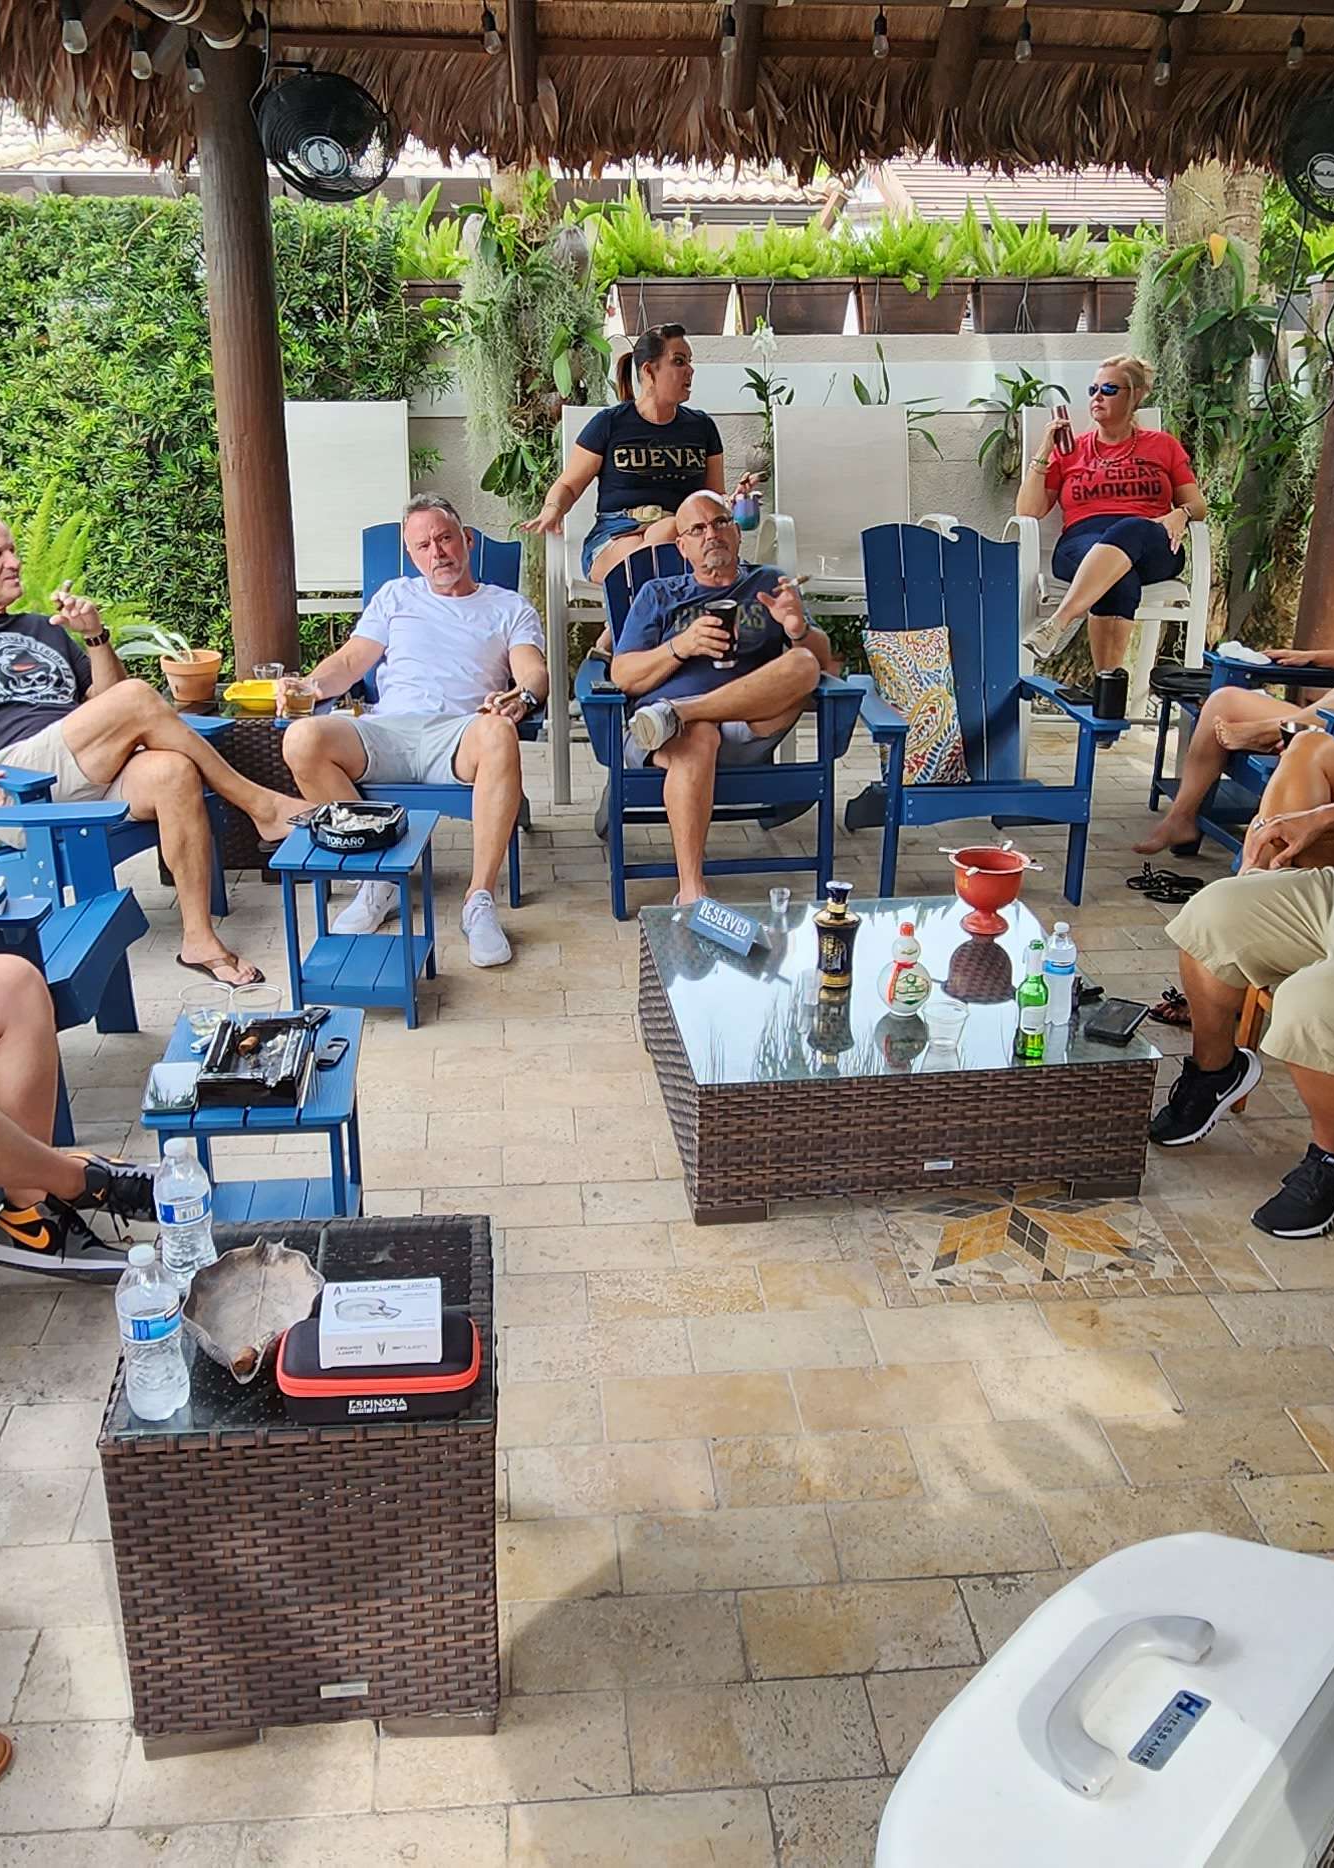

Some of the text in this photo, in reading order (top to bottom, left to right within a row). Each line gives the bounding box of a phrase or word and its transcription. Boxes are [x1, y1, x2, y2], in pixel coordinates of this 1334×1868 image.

[698, 901, 751, 937] RESERVED
[348, 1398, 407, 1409] ESPINOSA
[1138, 1712, 1183, 1765] HESSAIRE
